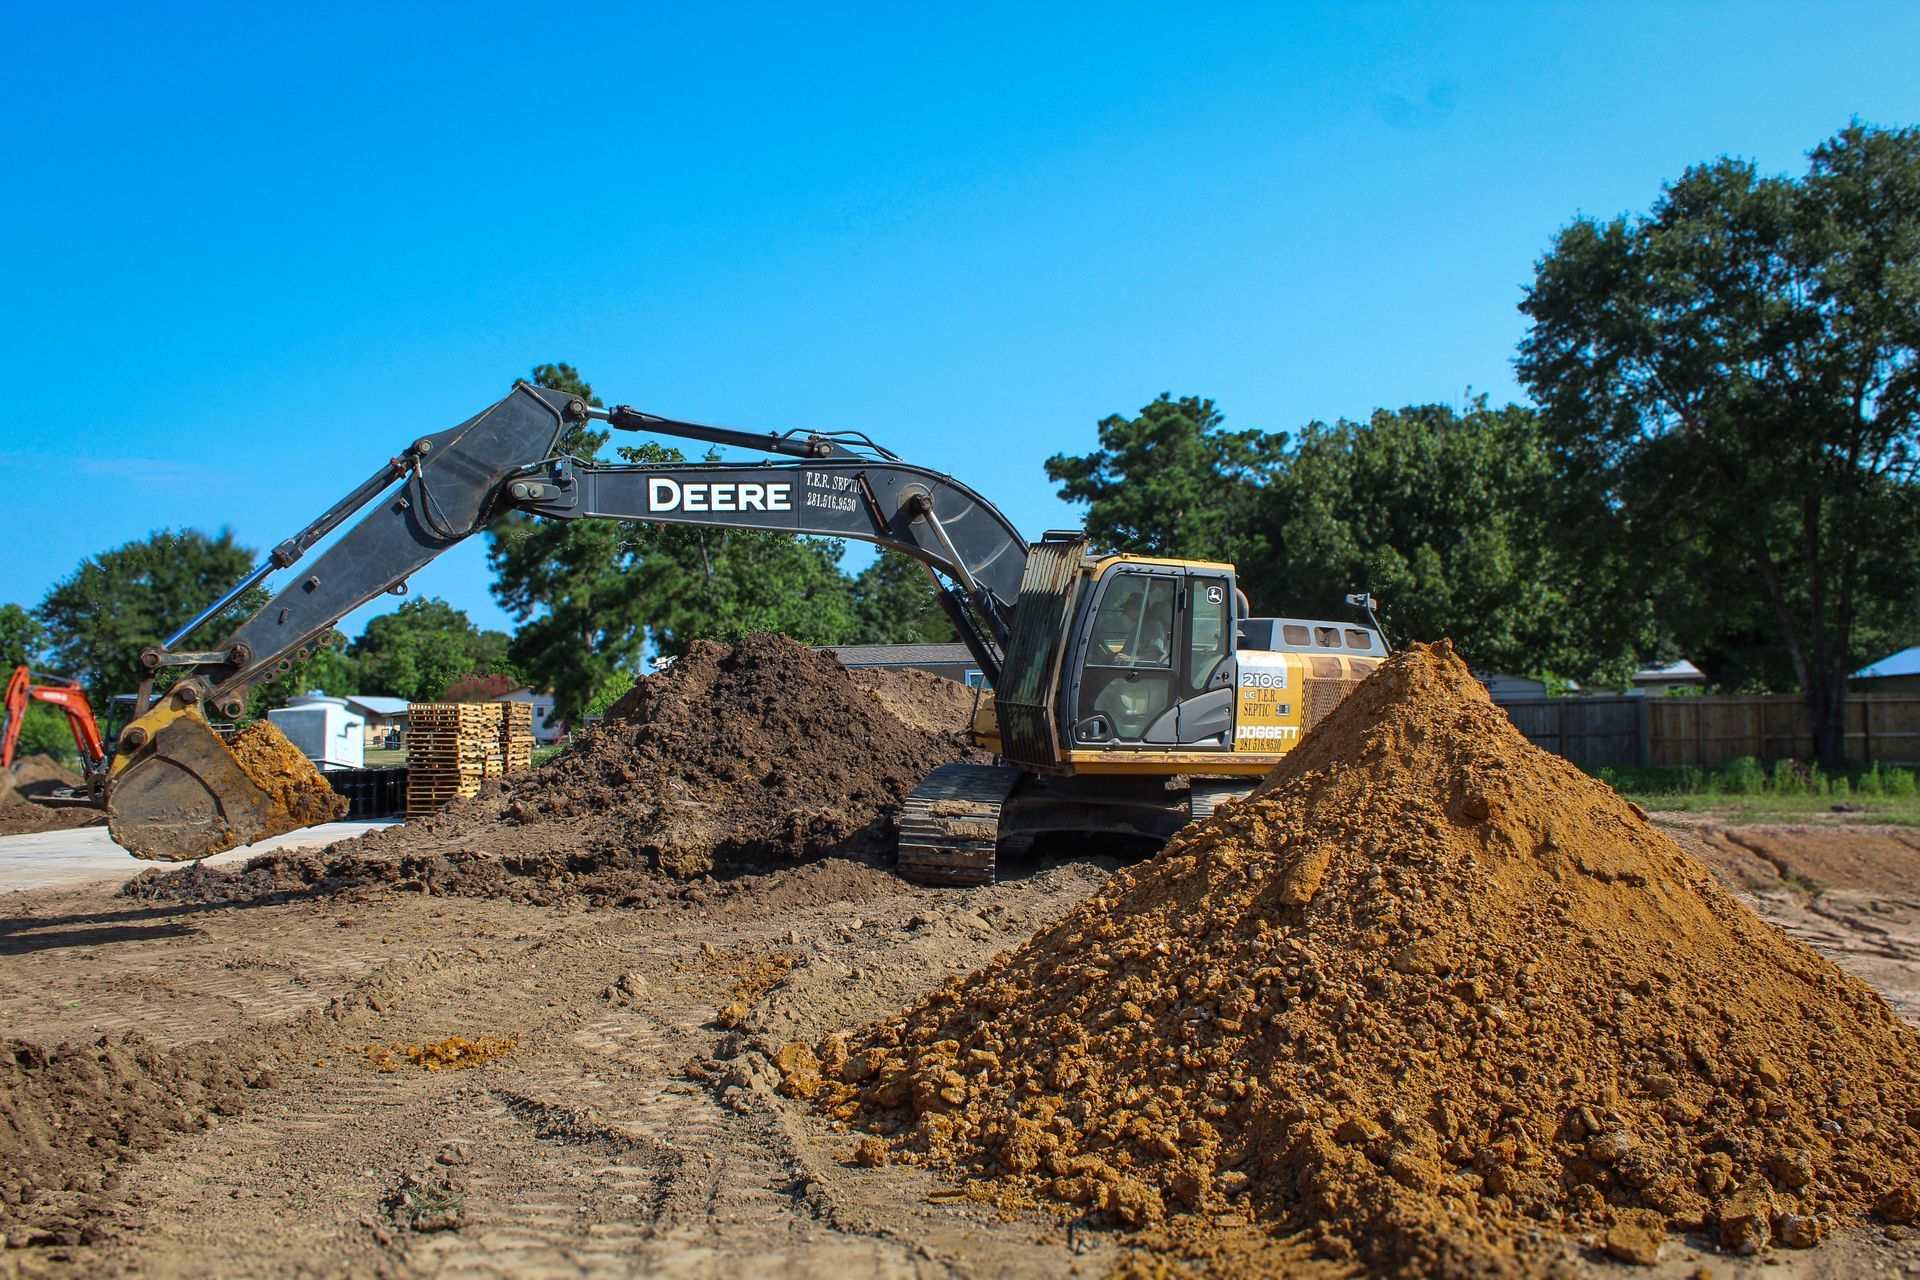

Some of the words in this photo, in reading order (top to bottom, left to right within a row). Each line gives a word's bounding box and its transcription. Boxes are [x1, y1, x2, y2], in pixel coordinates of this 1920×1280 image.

[806, 471, 829, 489] T.E.R.
[649, 478, 791, 512] DEERE
[807, 492, 857, 512] 281.516.9530
[1243, 673, 1283, 688] 210G
[1244, 691, 1256, 699] LC
[1257, 689, 1277, 702] T.E.R.
[1243, 703, 1270, 717] SEPTIC
[1236, 725, 1299, 739] DOGGETT
